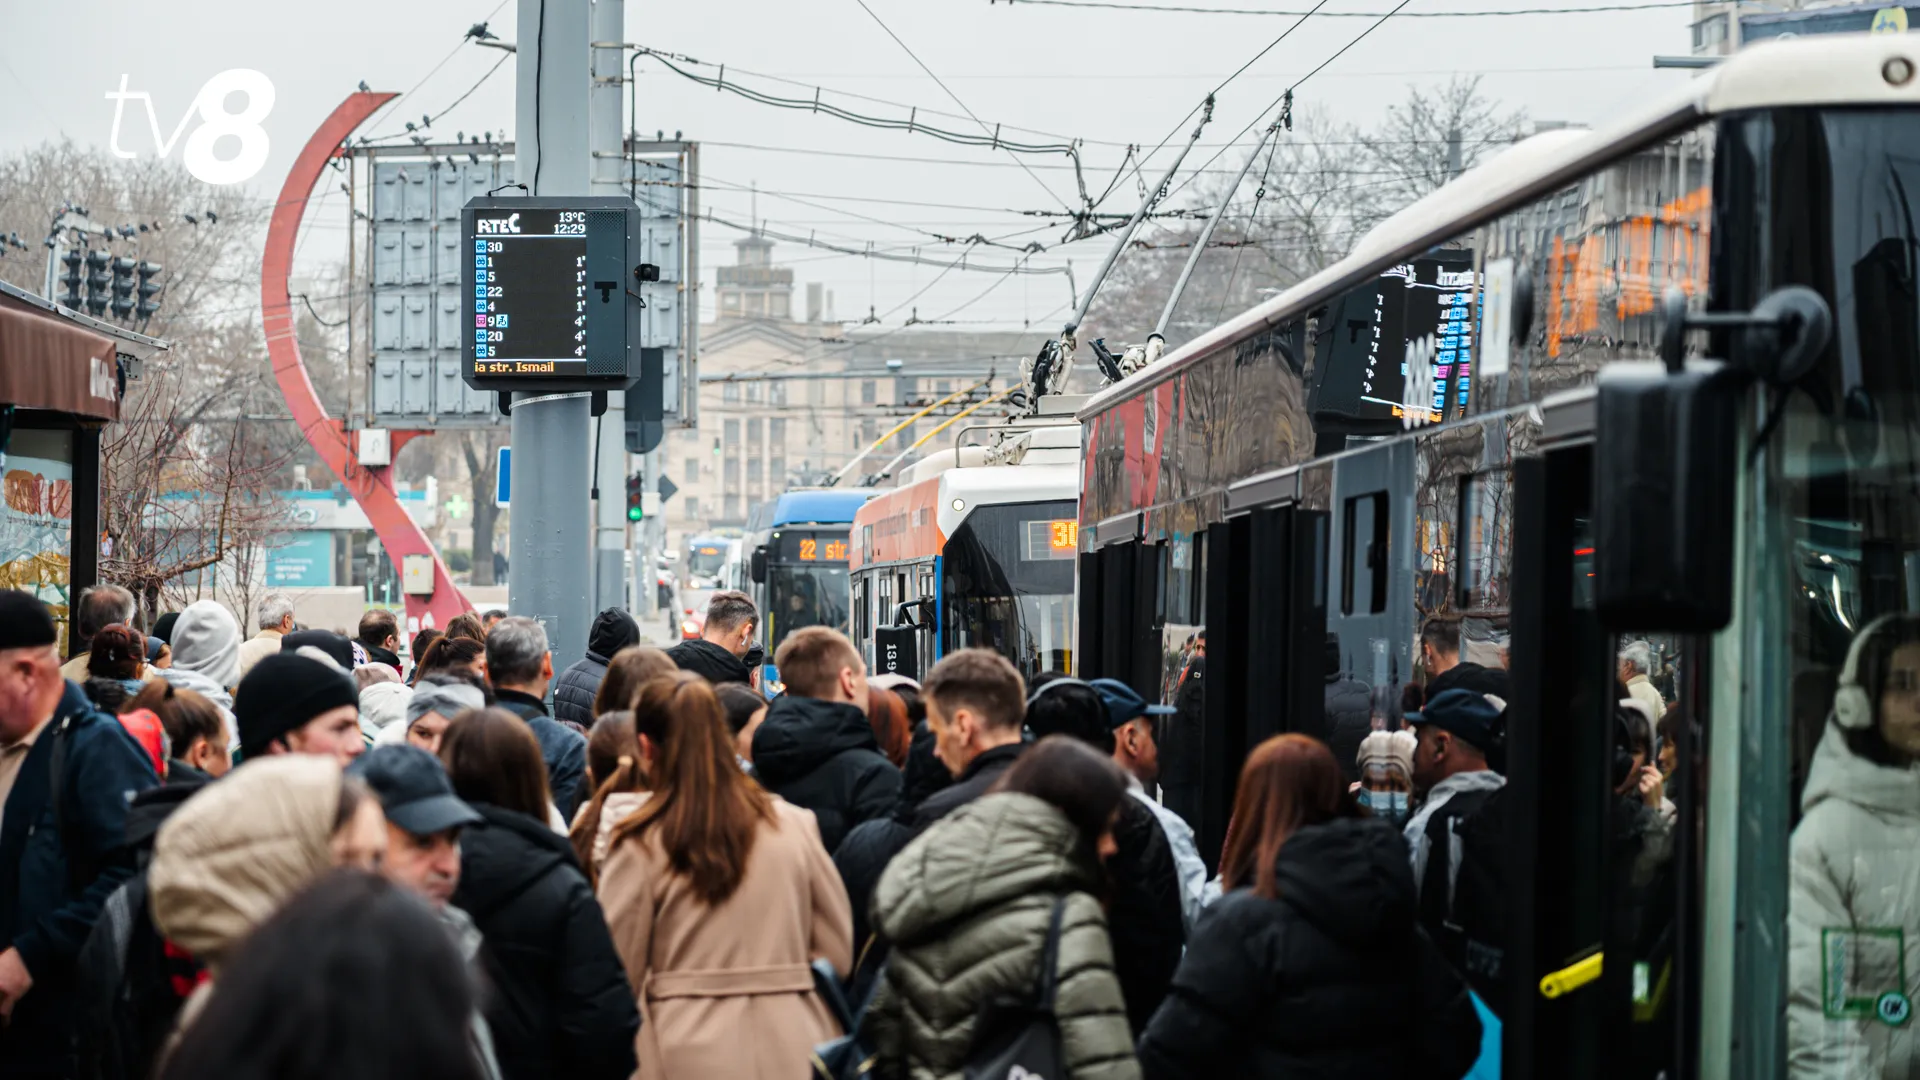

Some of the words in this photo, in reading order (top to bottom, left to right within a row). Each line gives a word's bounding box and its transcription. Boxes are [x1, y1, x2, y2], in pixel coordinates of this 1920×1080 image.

[559, 212, 586, 223] 13°C
[553, 223, 586, 234] 12:29
[487, 242, 503, 252] 30
[487, 256, 493, 267] 1
[487, 271, 496, 282] 5
[487, 286, 503, 297] 22
[487, 301, 496, 312] 4
[487, 316, 496, 327] 9
[487, 331, 503, 342] 20
[487, 346, 496, 357] 5
[489, 362, 513, 373] str.
[515, 361, 555, 373] Ismail
[799, 539, 817, 559] 22
